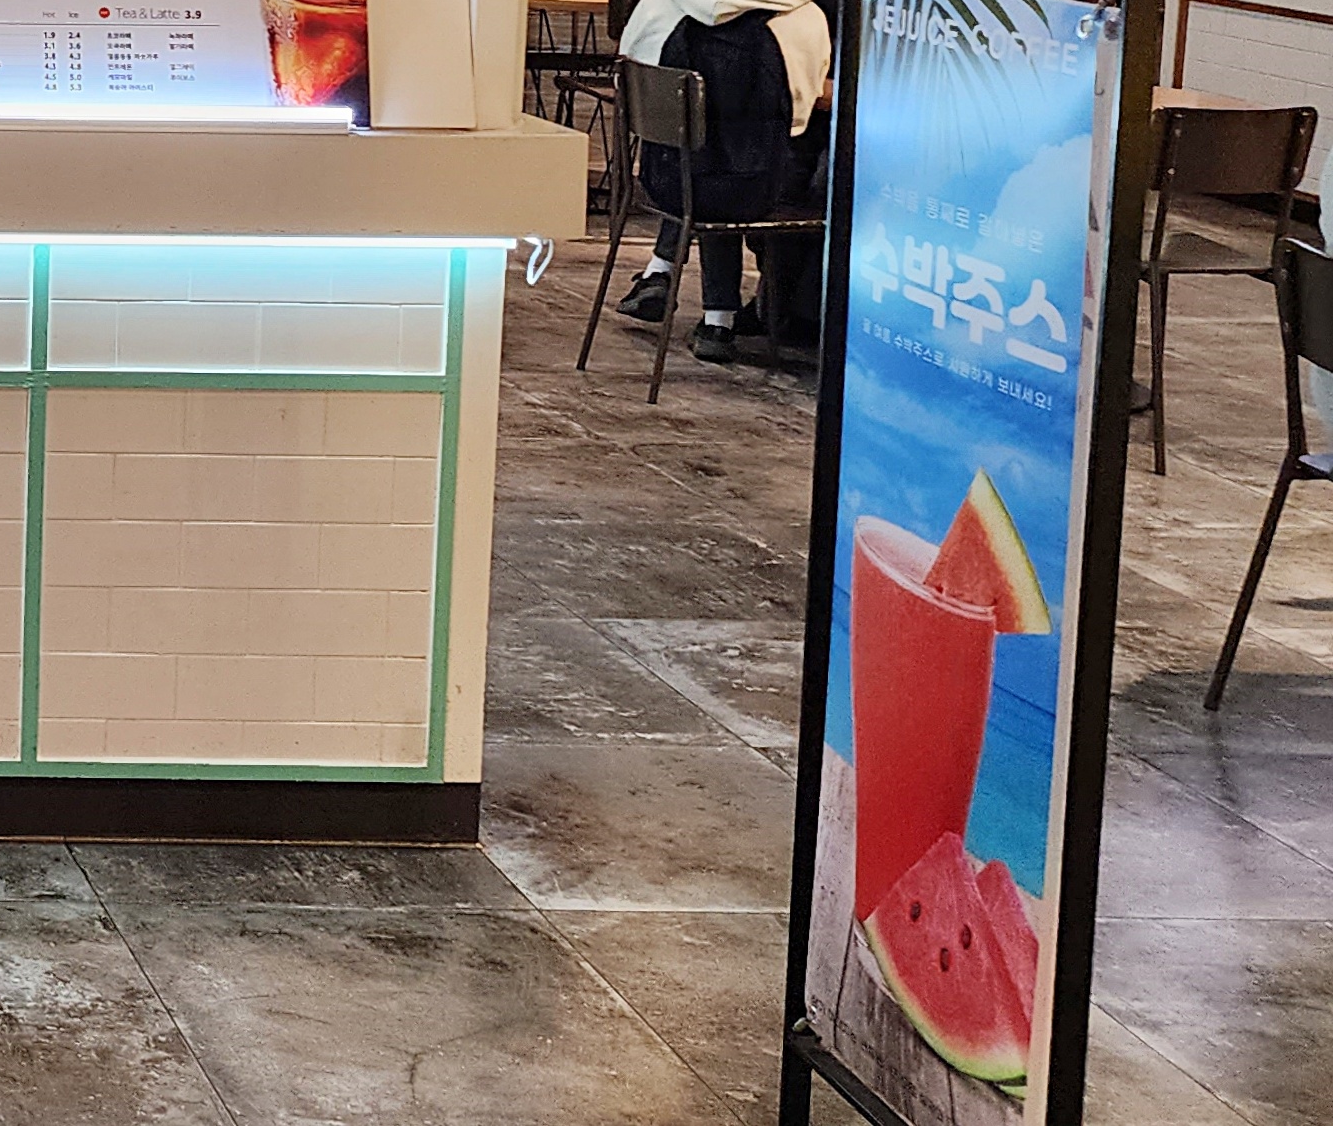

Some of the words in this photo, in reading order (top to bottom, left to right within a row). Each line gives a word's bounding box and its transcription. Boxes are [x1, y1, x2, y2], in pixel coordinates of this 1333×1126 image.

[115, 8, 136, 19] Tea
[139, 8, 148, 19] &
[150, 8, 180, 19] Latte
[184, 10, 201, 19] 3.9
[872, 1, 959, 50] JEJUICE
[972, 24, 1080, 77] COFFEE
[858, 221, 1067, 373] 수박주스
[894, 335, 943, 367] 수박주스로
[998, 377, 1053, 411] 보내세요!
